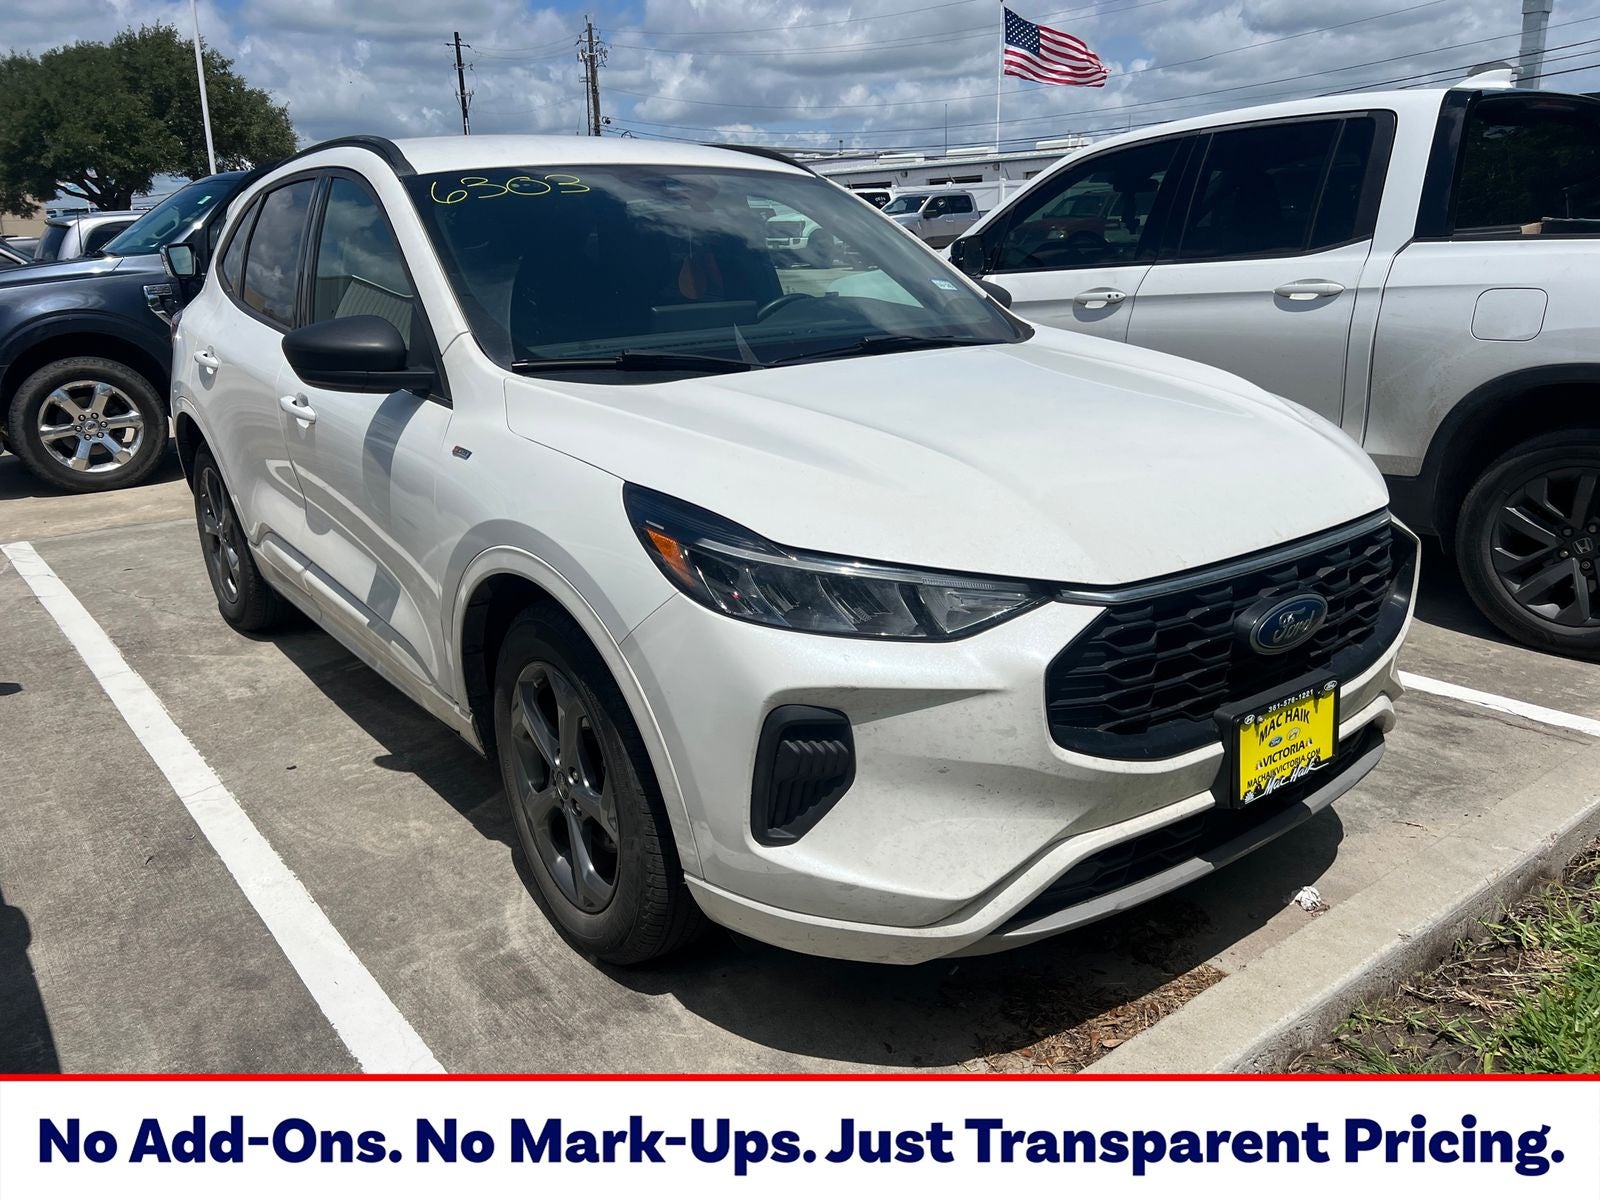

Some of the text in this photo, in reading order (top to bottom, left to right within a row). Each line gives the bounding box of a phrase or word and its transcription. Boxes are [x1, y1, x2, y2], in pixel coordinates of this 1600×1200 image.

[430, 173, 591, 204] 6303
[1272, 606, 1315, 643] Ford
[1259, 707, 1310, 746] MAC HAIK
[1263, 740, 1305, 768] VICTORIA
[1262, 755, 1321, 795] Mac Haik
